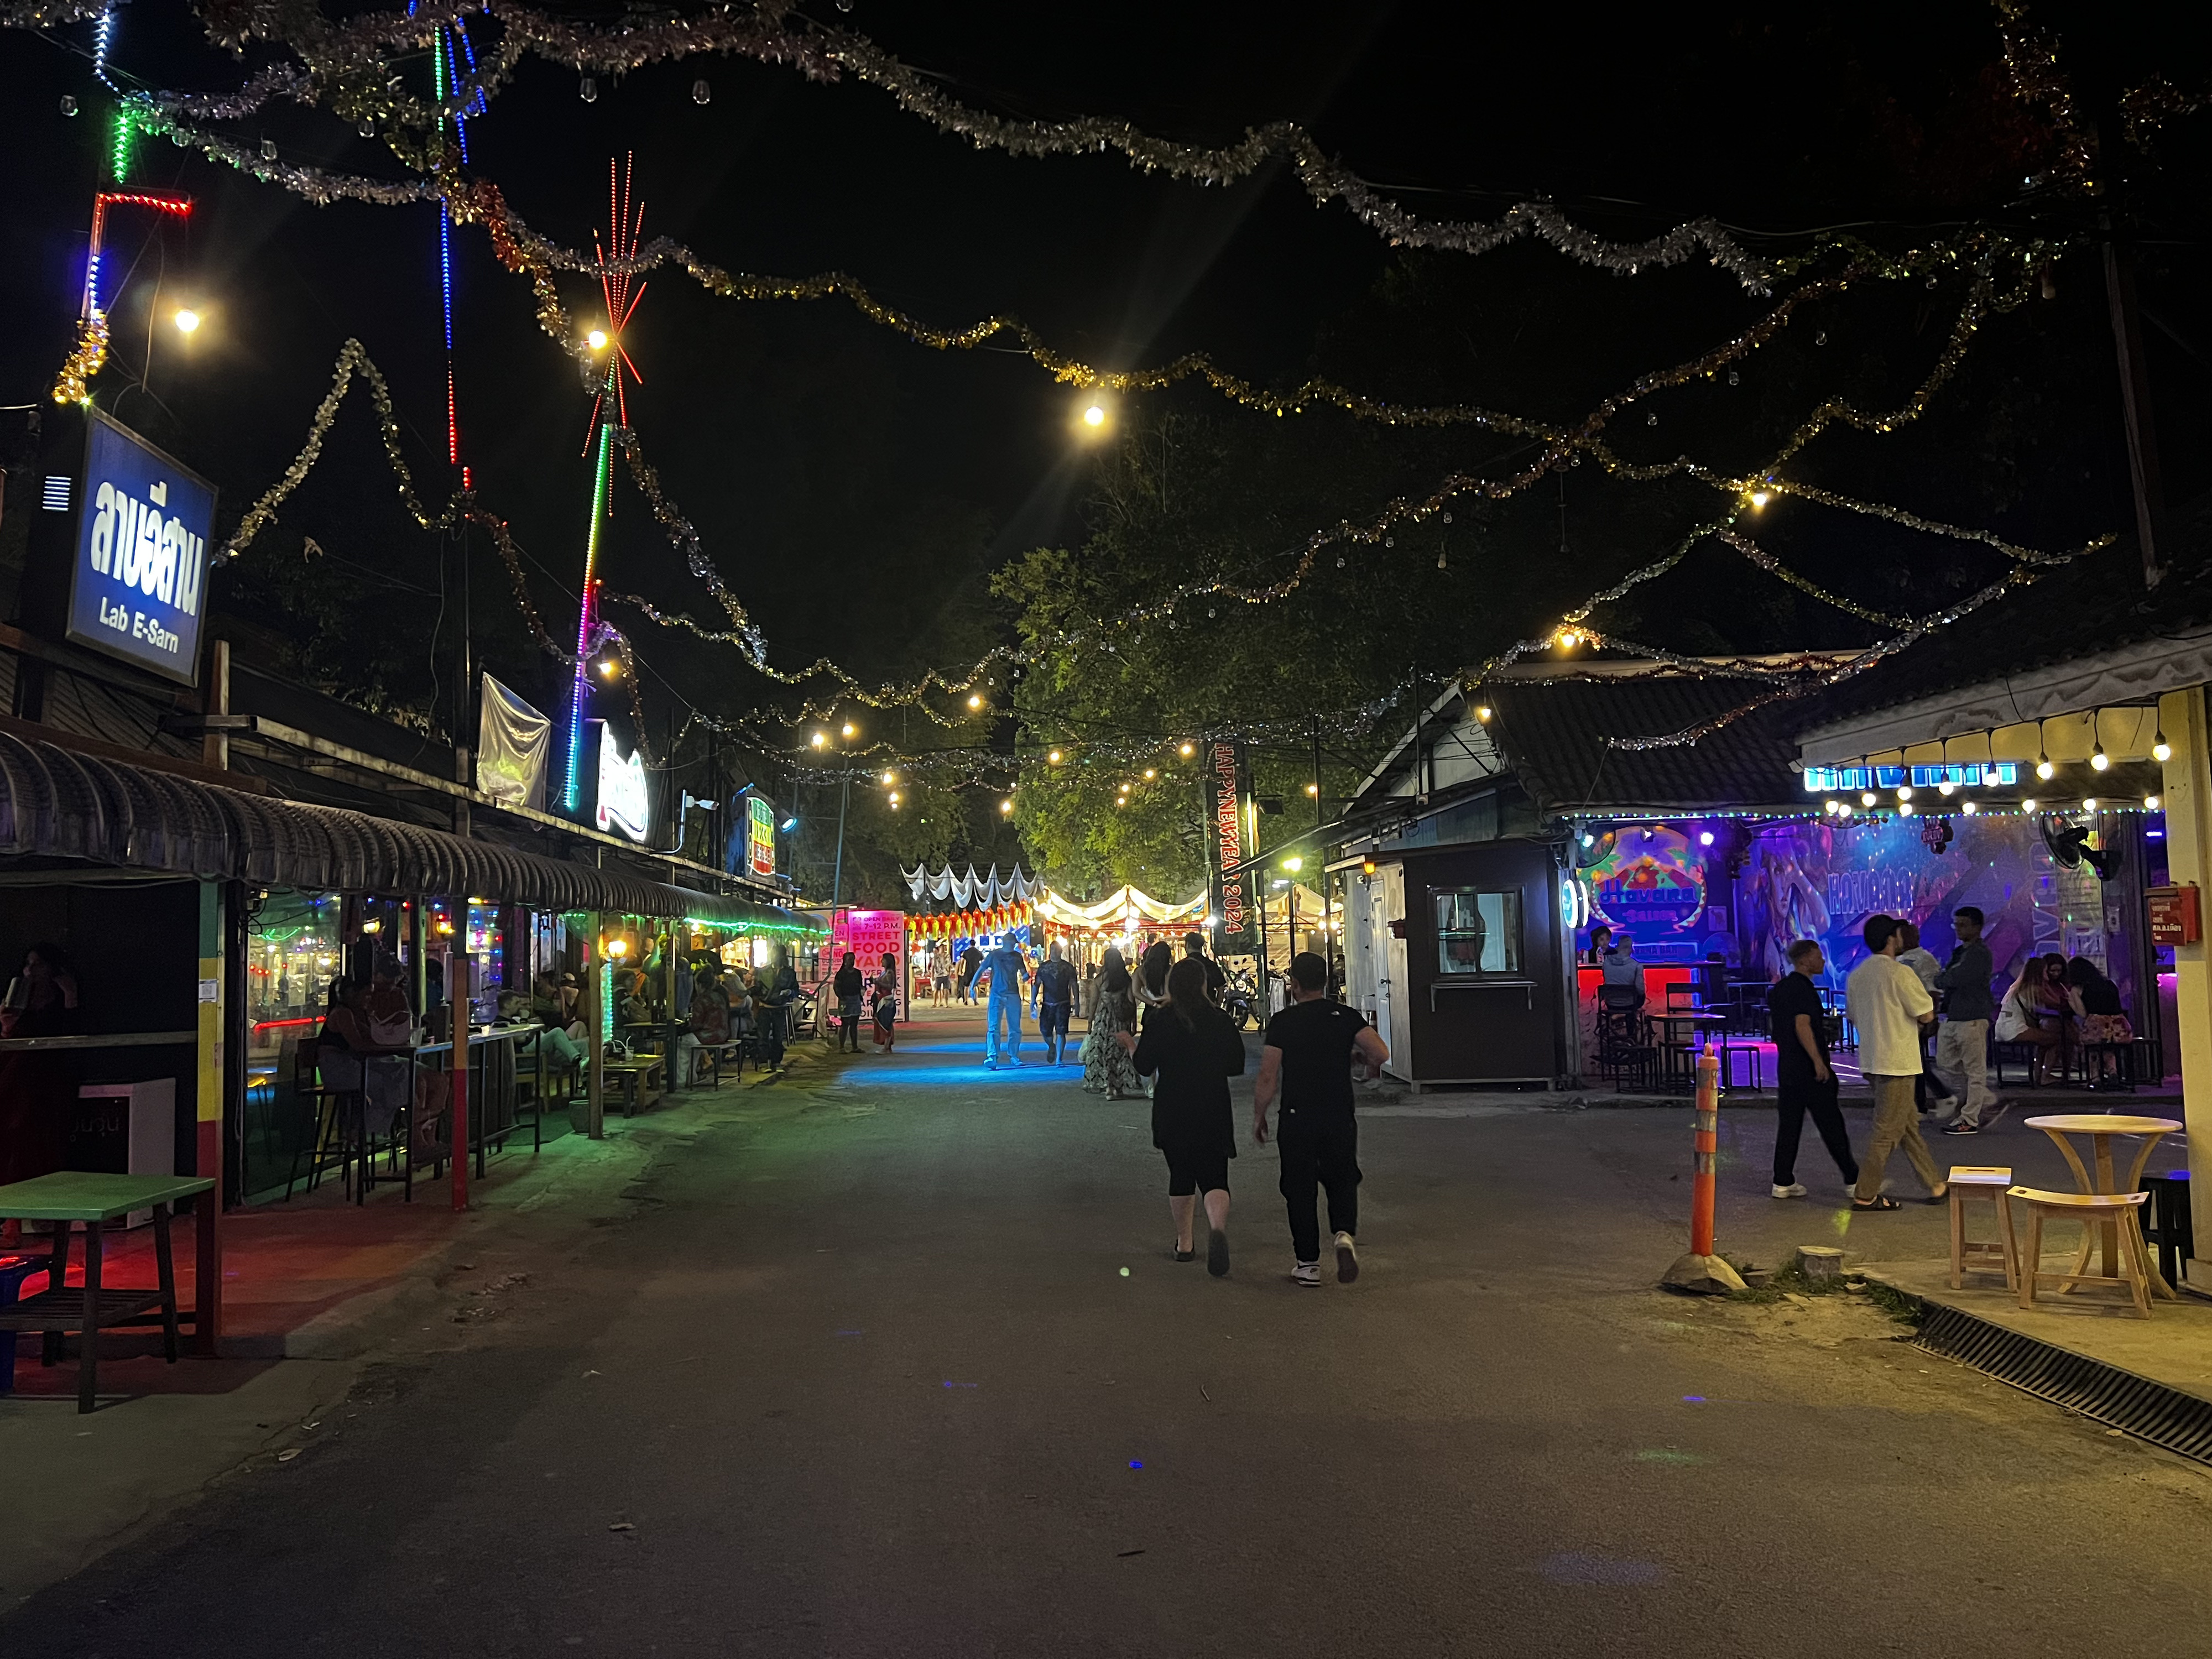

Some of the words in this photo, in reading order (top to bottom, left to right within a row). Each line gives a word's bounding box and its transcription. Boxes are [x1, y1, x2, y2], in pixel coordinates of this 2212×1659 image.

[100, 597, 128, 632] Lab
[1828, 866, 1913, 915] HAVANA
[1222, 884, 1245, 936] 2024
[852, 931, 900, 940] STREET
[853, 942, 900, 953] FOOD
